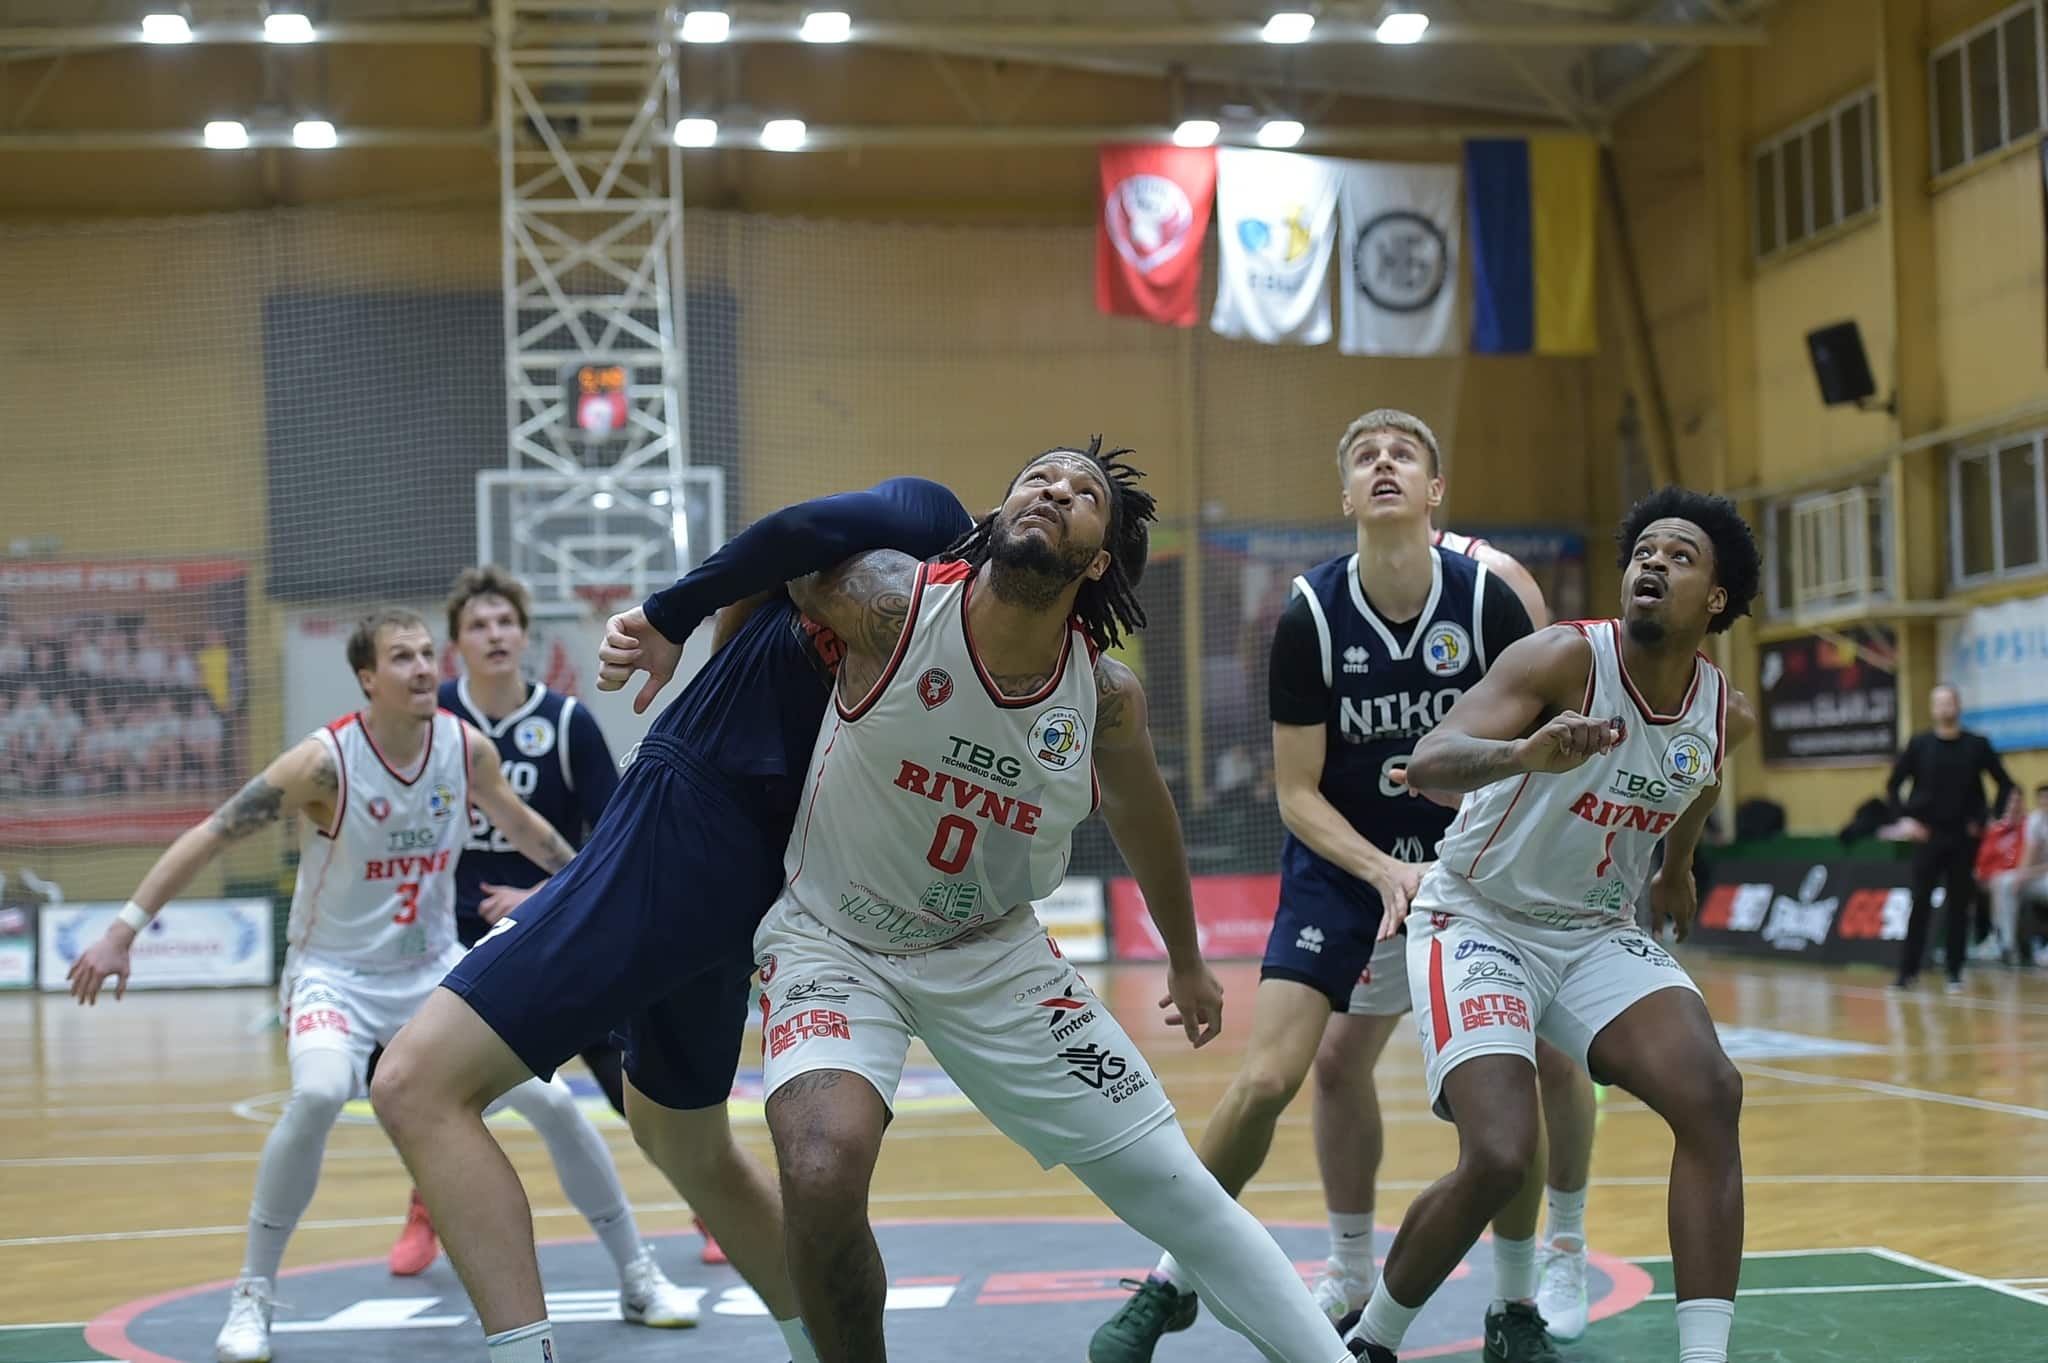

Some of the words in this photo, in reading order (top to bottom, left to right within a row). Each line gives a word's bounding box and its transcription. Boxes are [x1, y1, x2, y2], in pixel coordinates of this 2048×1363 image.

[942, 755, 989, 778] TECHNOBUD
[990, 773, 1018, 787] GROUP
[949, 735, 1022, 779] TBG
[893, 759, 1043, 835] RIVNE
[1617, 769, 1667, 797] TBG
[926, 814, 978, 875] 0
[393, 882, 421, 925] 3
[1459, 993, 1528, 1018] INTER
[1462, 1010, 1531, 1033] BETON
[769, 1009, 848, 1045] INTER
[771, 1023, 851, 1060] BETON
[1051, 1010, 1097, 1042] imtrex
[1102, 1070, 1142, 1098] VECTOR
[1112, 1079, 1149, 1104] GLOBAL
